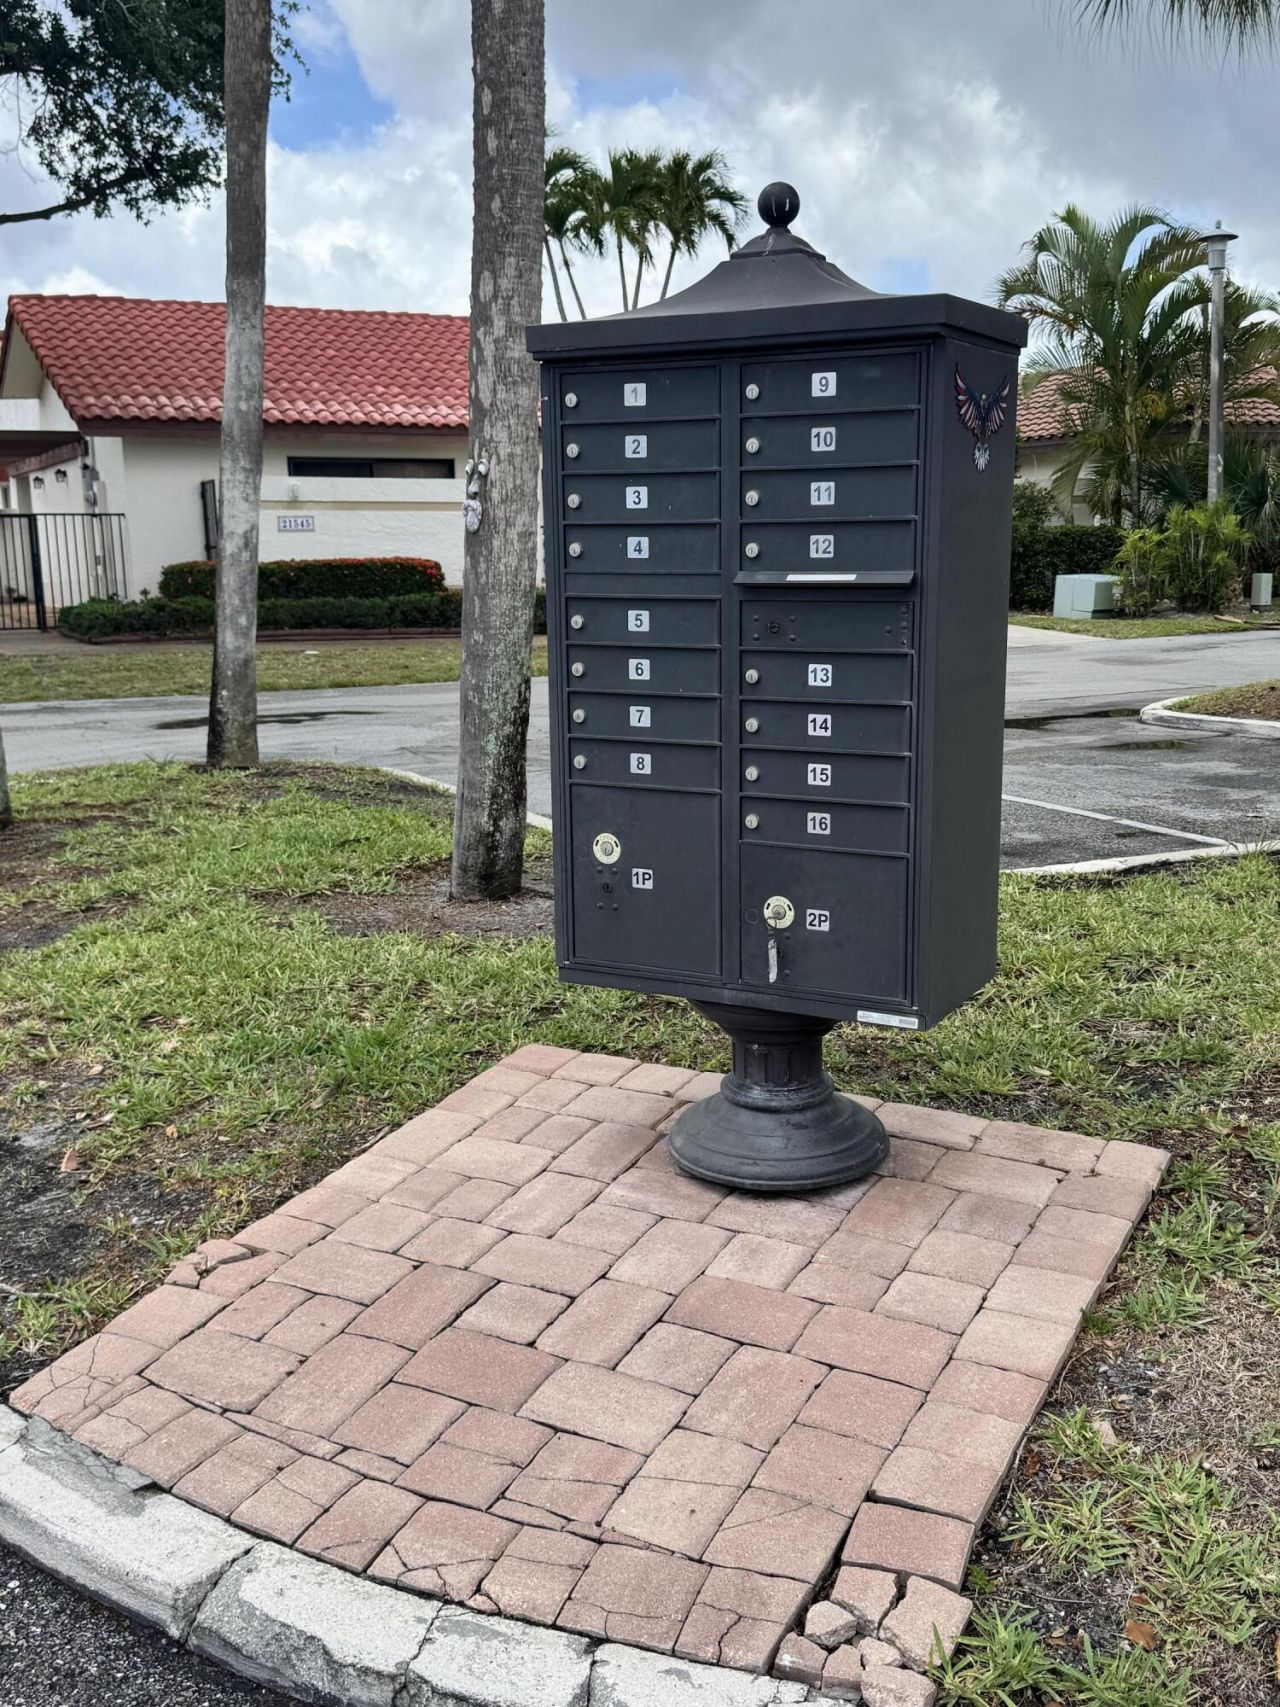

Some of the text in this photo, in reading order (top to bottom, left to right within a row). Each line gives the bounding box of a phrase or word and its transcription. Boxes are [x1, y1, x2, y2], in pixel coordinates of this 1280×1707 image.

[819, 376, 829, 393] 9
[630, 386, 638, 403] 1
[631, 438, 641, 455] 2
[813, 430, 834, 448] 10
[632, 490, 642, 506] 3
[813, 485, 833, 502] 11
[633, 540, 643, 555] 4
[812, 538, 832, 555] 12
[634, 613, 643, 629] 5
[635, 662, 644, 677] 6
[810, 667, 830, 684] 13
[636, 709, 645, 724] 7
[809, 717, 829, 733] 14
[636, 756, 645, 771] 8
[809, 766, 829, 783] 15
[809, 815, 829, 832] 16
[633, 871, 652, 886] 1P
[808, 912, 828, 928] 2P
